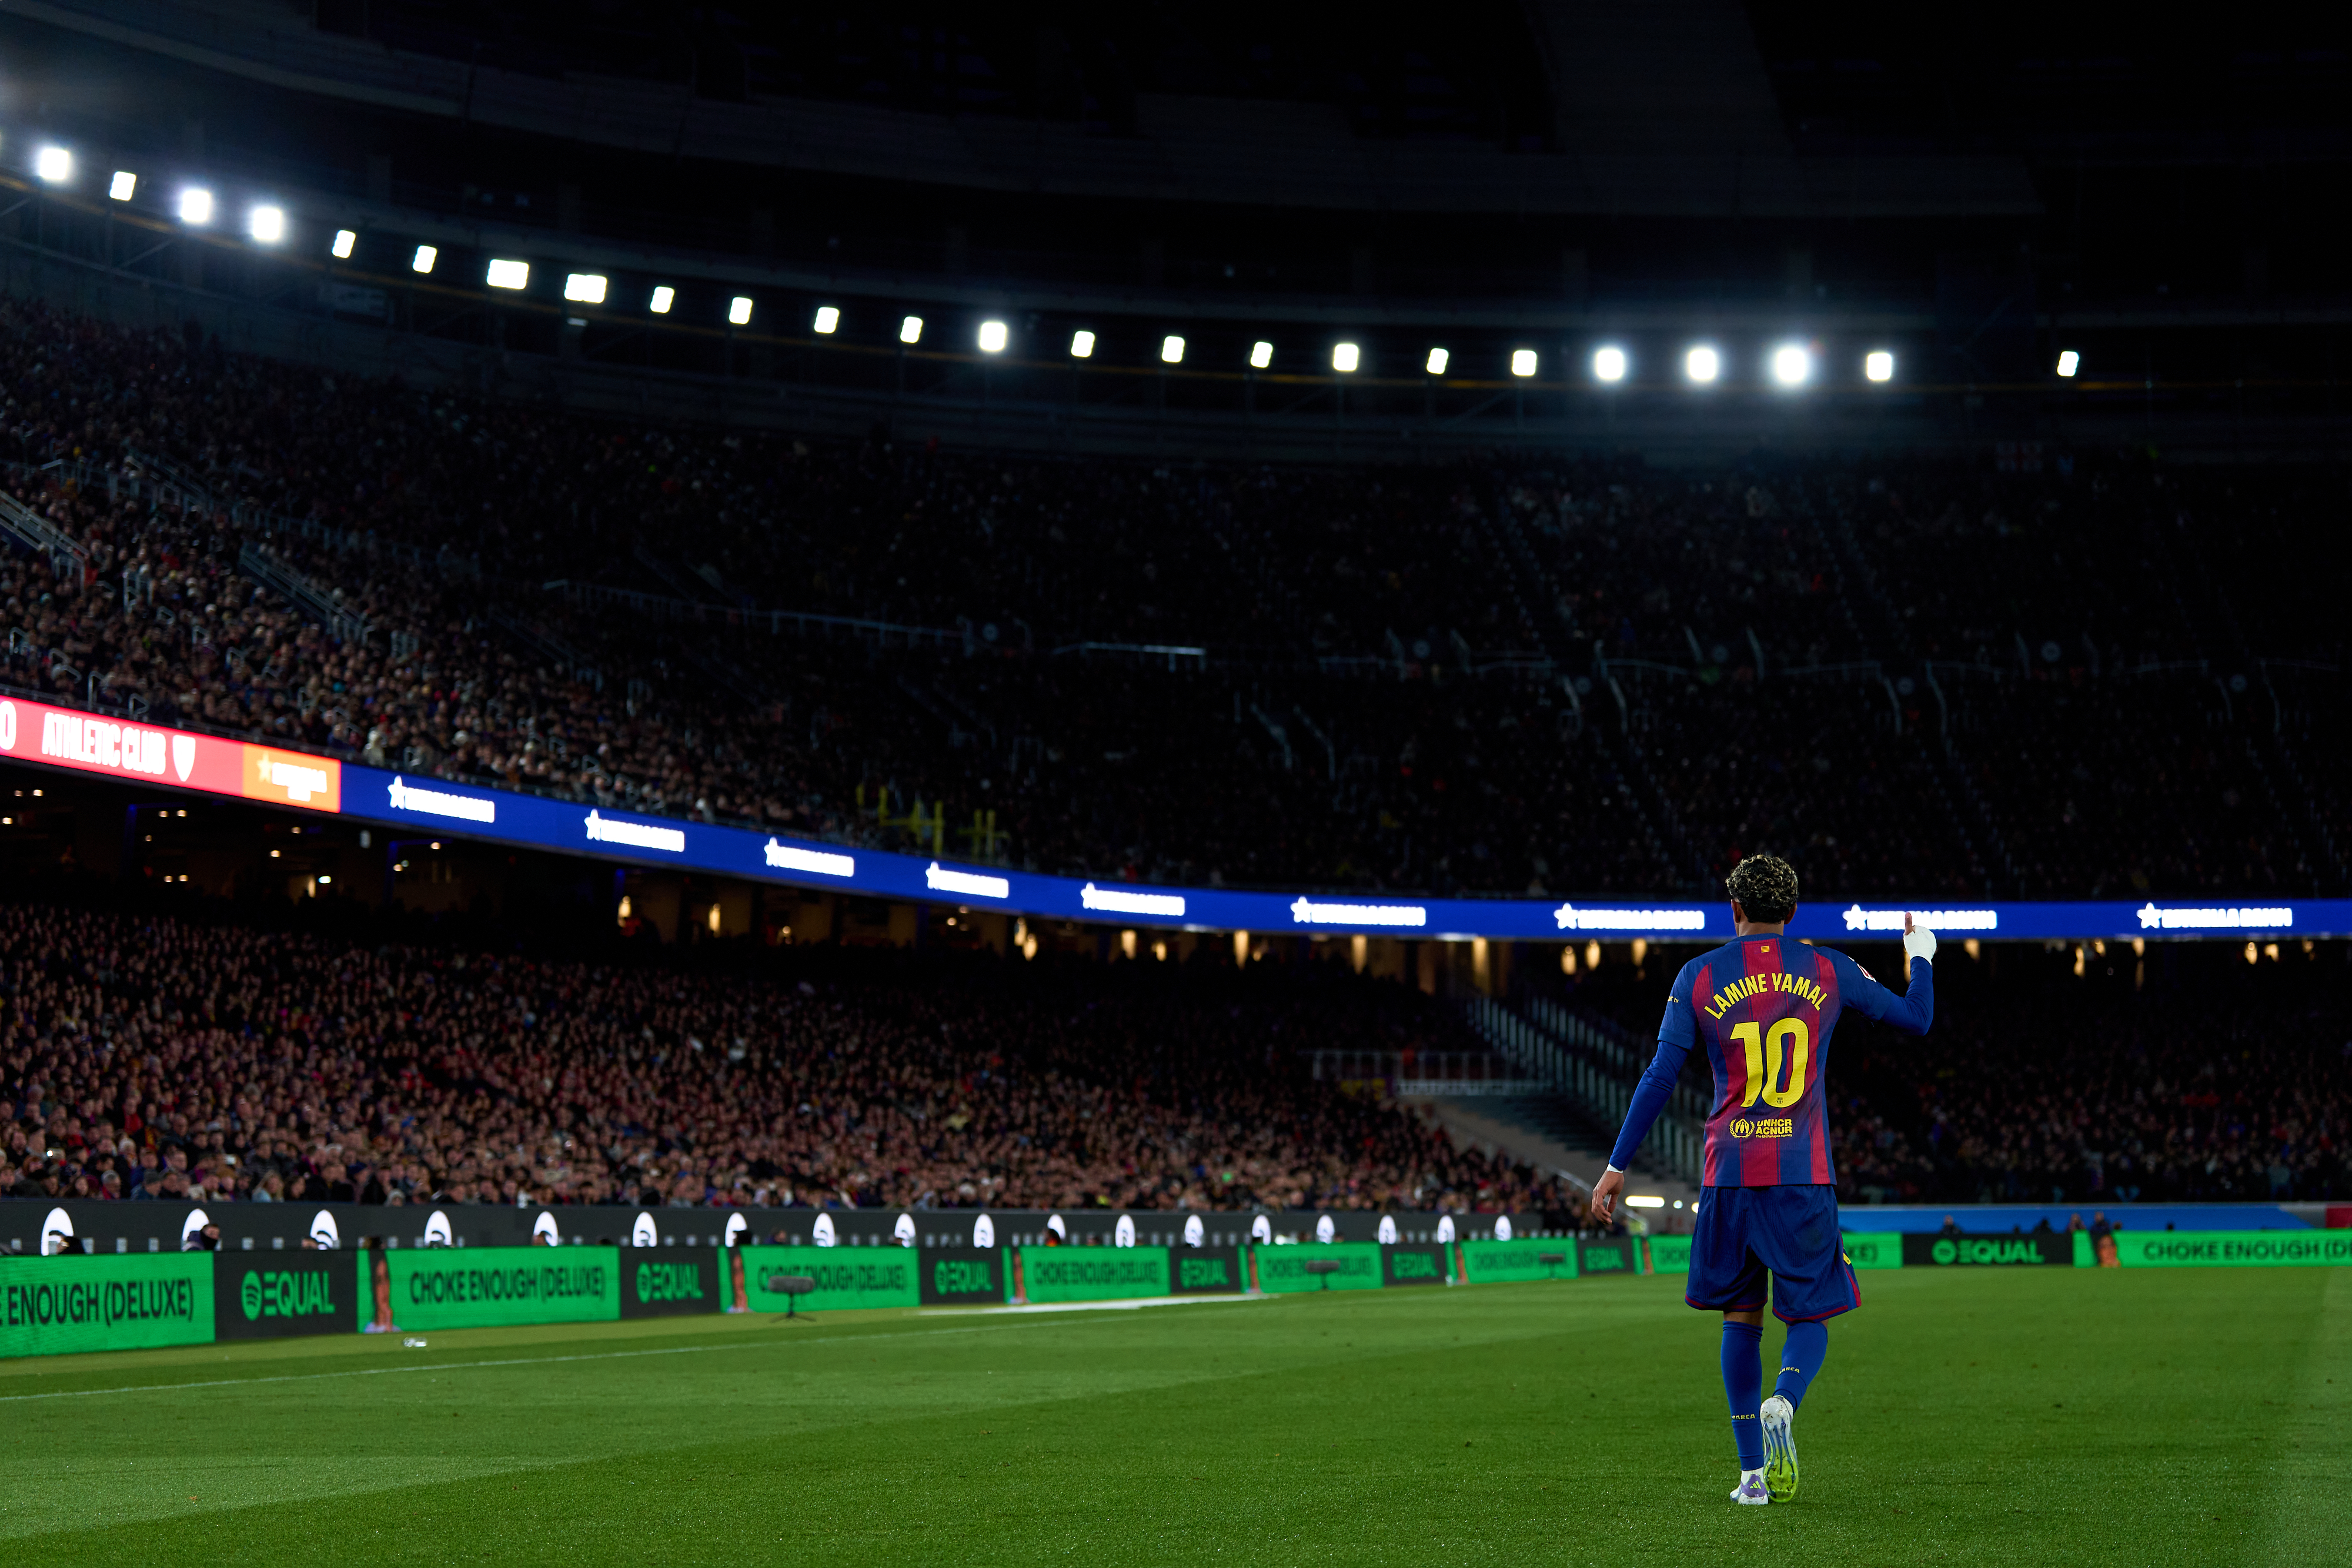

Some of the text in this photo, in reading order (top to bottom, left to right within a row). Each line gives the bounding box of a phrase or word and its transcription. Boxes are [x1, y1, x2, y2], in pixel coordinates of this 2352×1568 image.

[42, 712, 166, 775] ATHLETIC CLUB
[1704, 973, 1828, 1019] LAMINE YAMAL
[1730, 1017, 1809, 1108] 10
[1755, 1126, 1793, 1135] ACNUR
[1756, 1118, 1792, 1127] UNHCR
[1957, 1239, 2045, 1265] EQUAL
[2144, 1241, 2219, 1261] CHOKE
[2223, 1240, 2320, 1261] ENOUGH
[8, 1276, 193, 1327] ENOUGH (DELUXE)
[263, 1270, 336, 1319] EQUAL
[410, 1265, 606, 1305] CHOKE ENOUGH (DELUXE)
[651, 1262, 704, 1302] EQUAL
